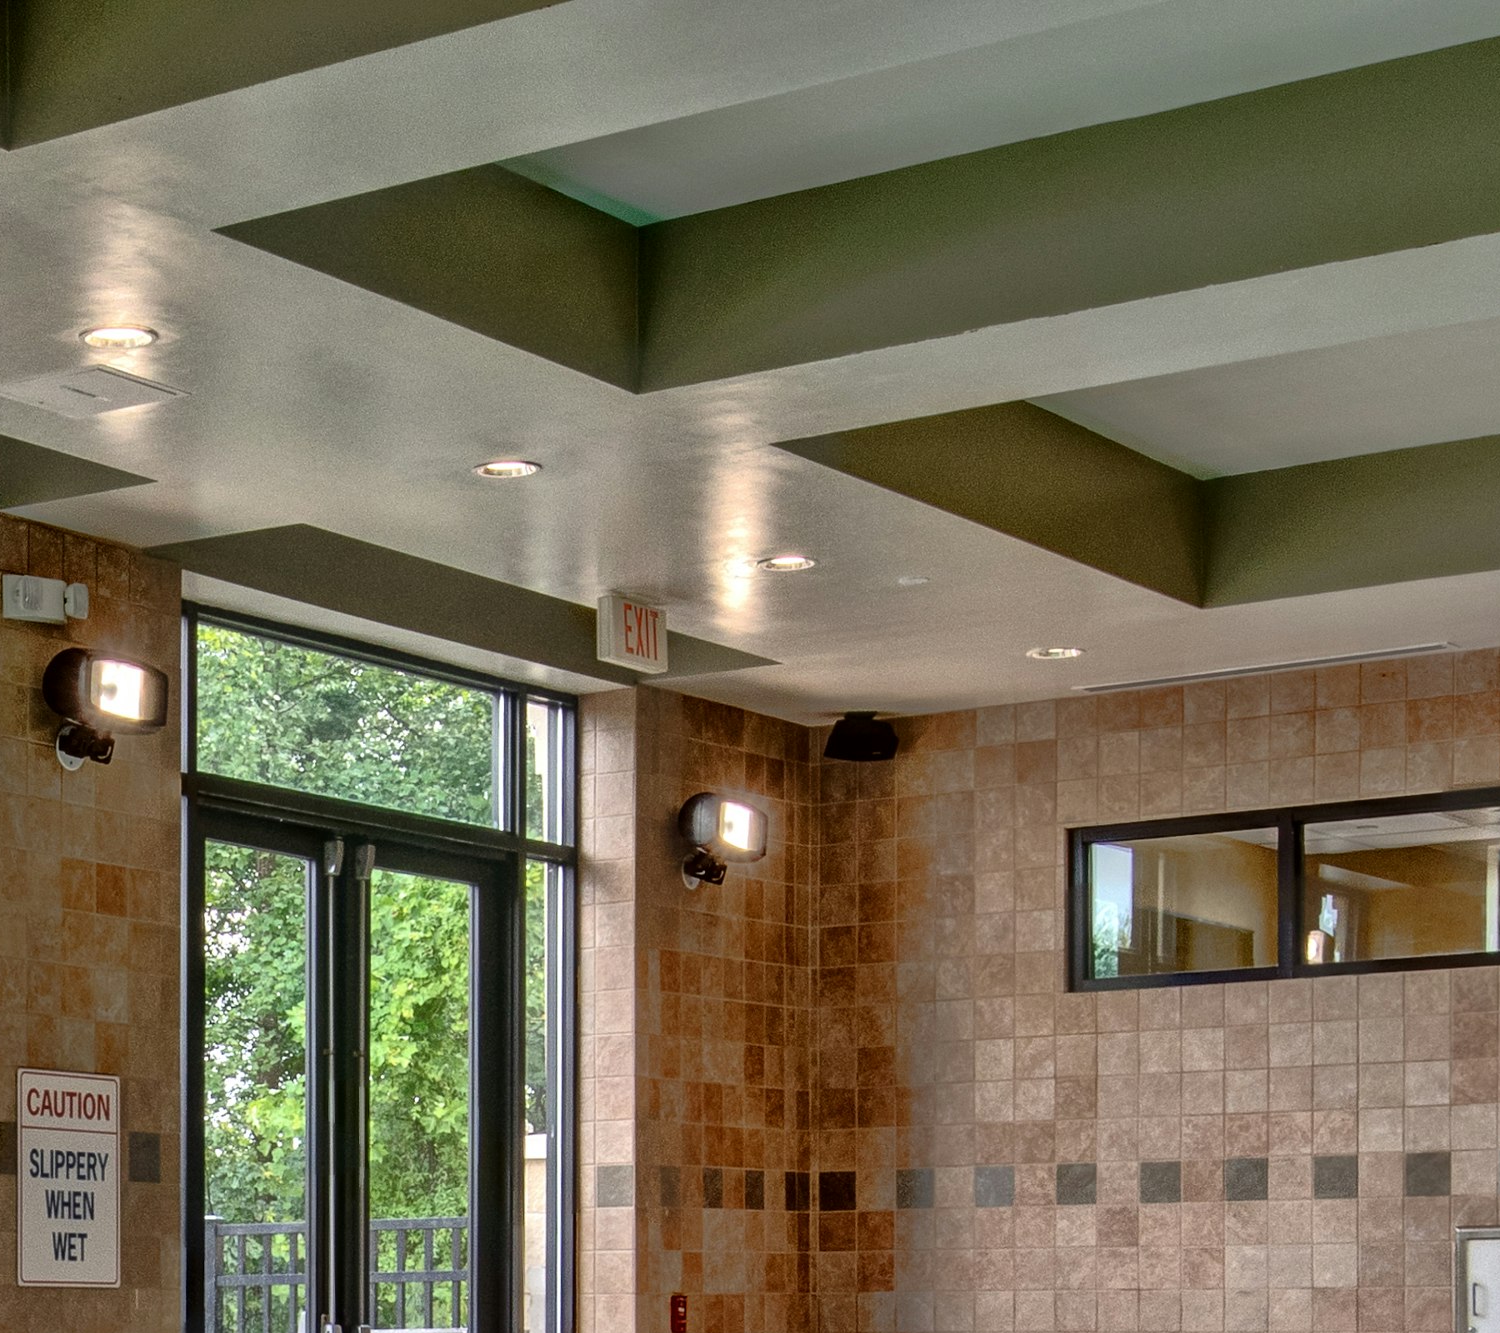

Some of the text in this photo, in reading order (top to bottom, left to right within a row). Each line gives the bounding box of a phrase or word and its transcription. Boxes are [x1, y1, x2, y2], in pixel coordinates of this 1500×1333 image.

[624, 603, 658, 661] EXIT
[27, 1087, 111, 1121] CAUTION
[29, 1148, 109, 1182] SLIPPERY
[45, 1189, 95, 1220] WHEN
[52, 1231, 88, 1262] WET
